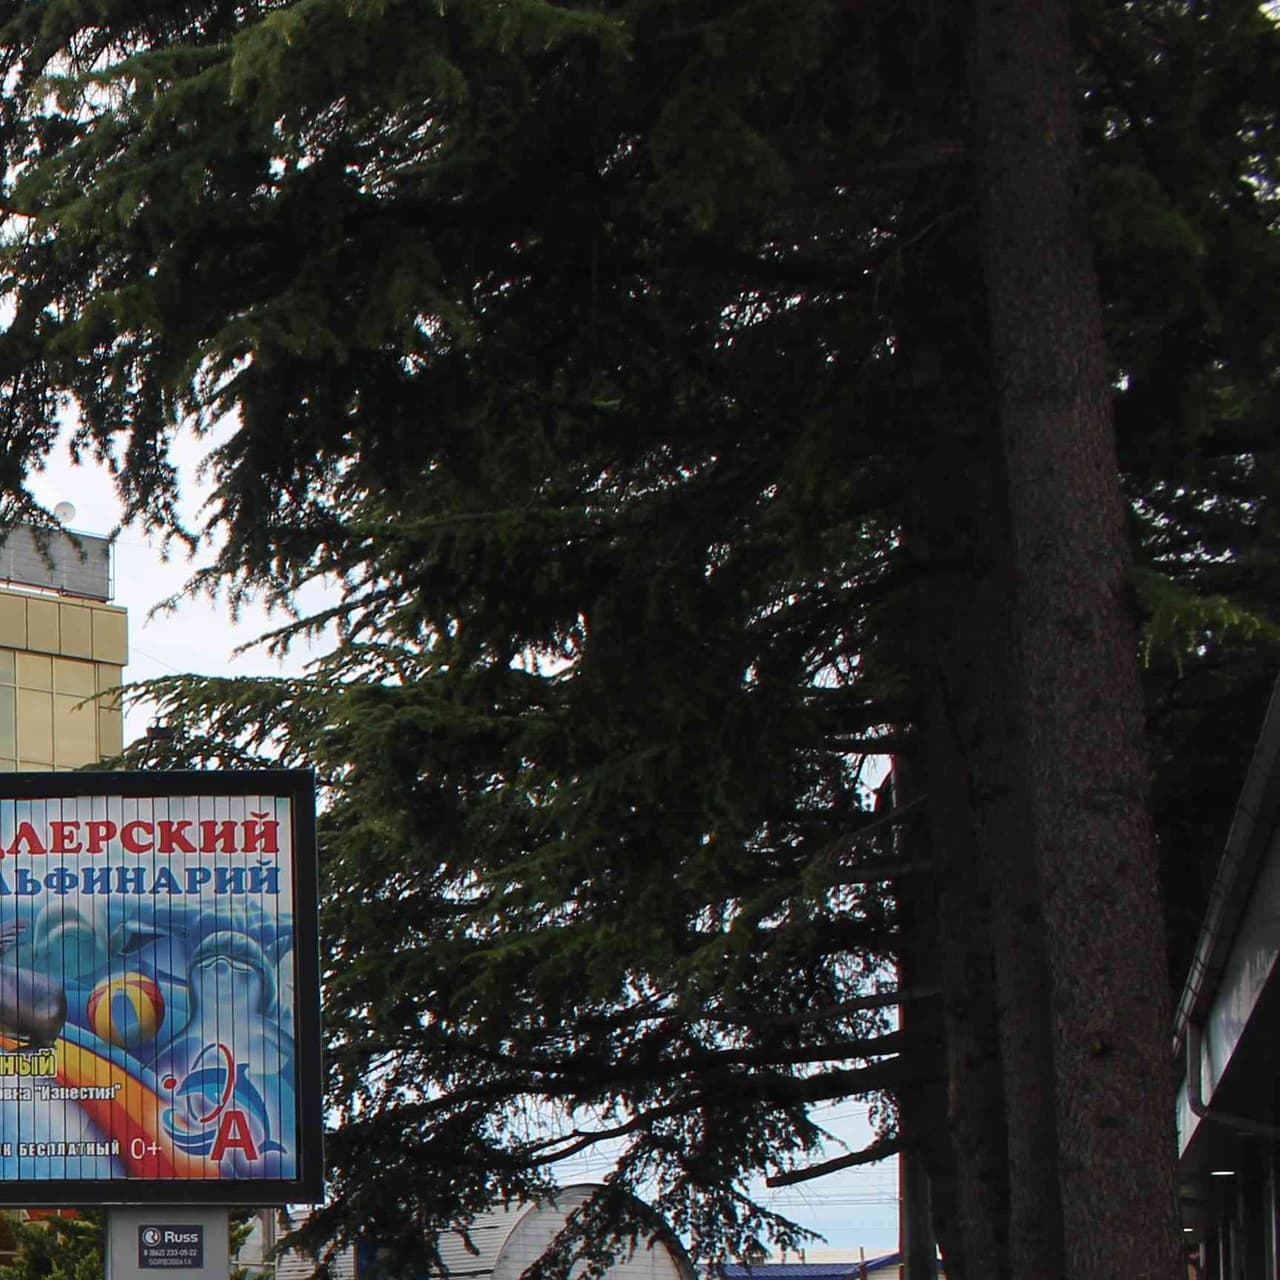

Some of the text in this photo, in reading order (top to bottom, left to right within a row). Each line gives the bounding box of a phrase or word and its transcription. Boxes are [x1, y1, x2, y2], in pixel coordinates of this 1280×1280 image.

[34, 1083, 121, 1100] "Известия"
[17, 1139, 120, 1157] БЕСПЛАТНЫЙ
[131, 1138, 162, 1160] 0+
[164, 1231, 199, 1243] Russ
